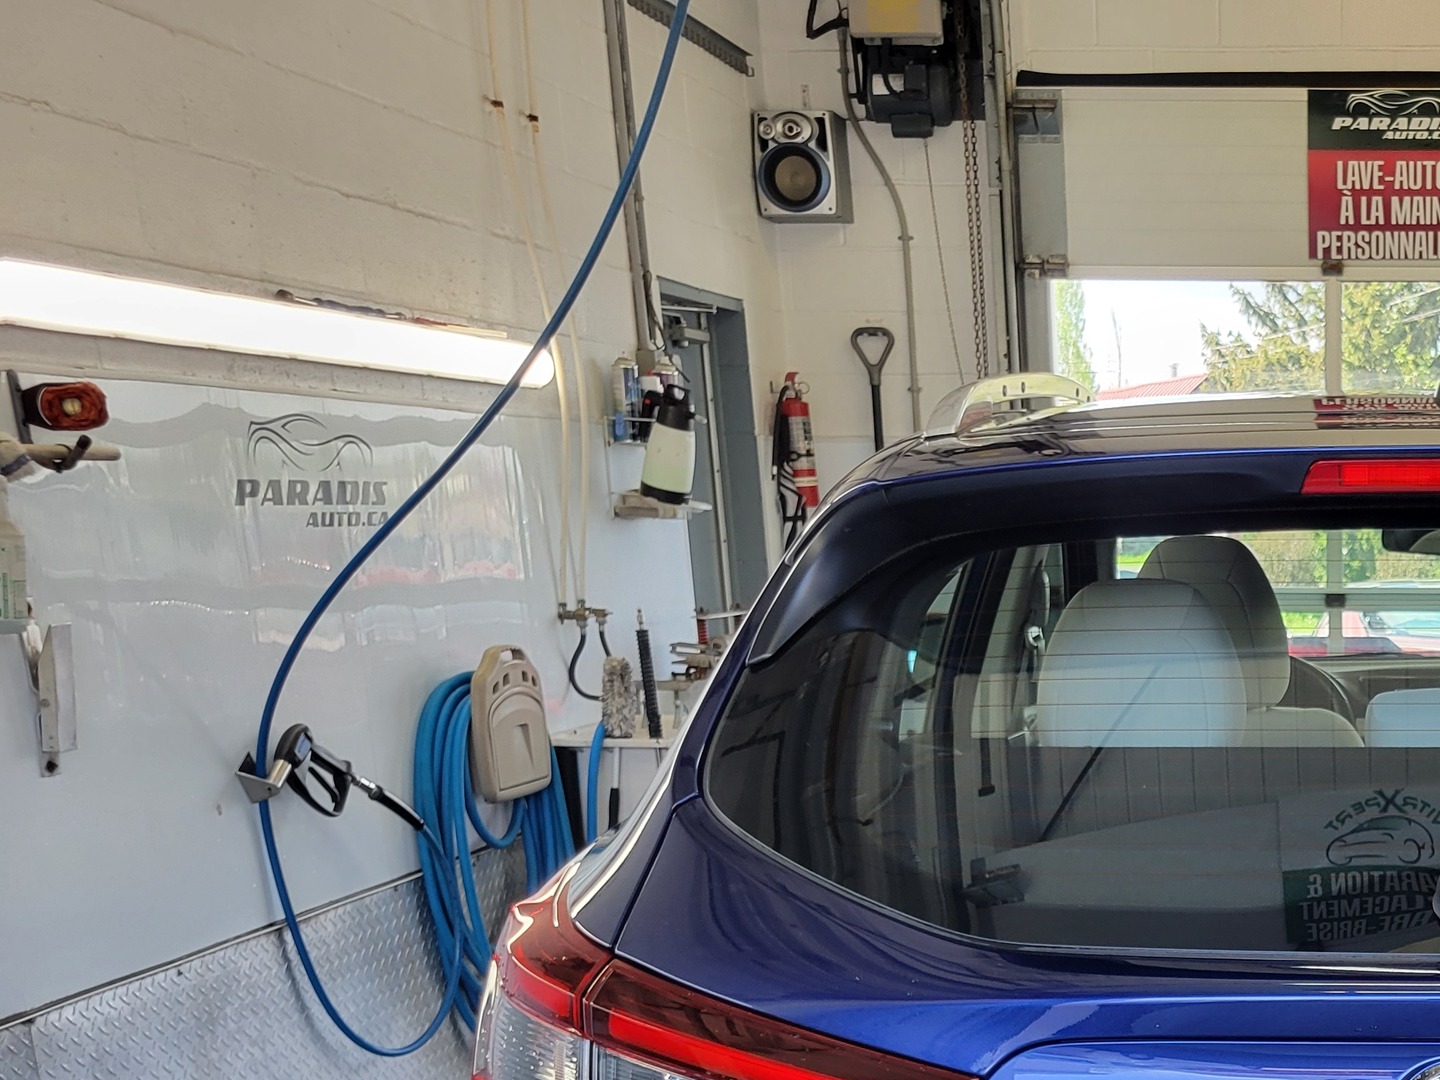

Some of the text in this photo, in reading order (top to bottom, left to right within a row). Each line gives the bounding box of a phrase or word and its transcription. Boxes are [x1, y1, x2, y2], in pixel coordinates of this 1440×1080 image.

[1339, 189, 1355, 225] À
[1360, 196, 1385, 225] LA
[234, 479, 388, 506] PARADIS
[306, 511, 389, 528] AUTO.CA
